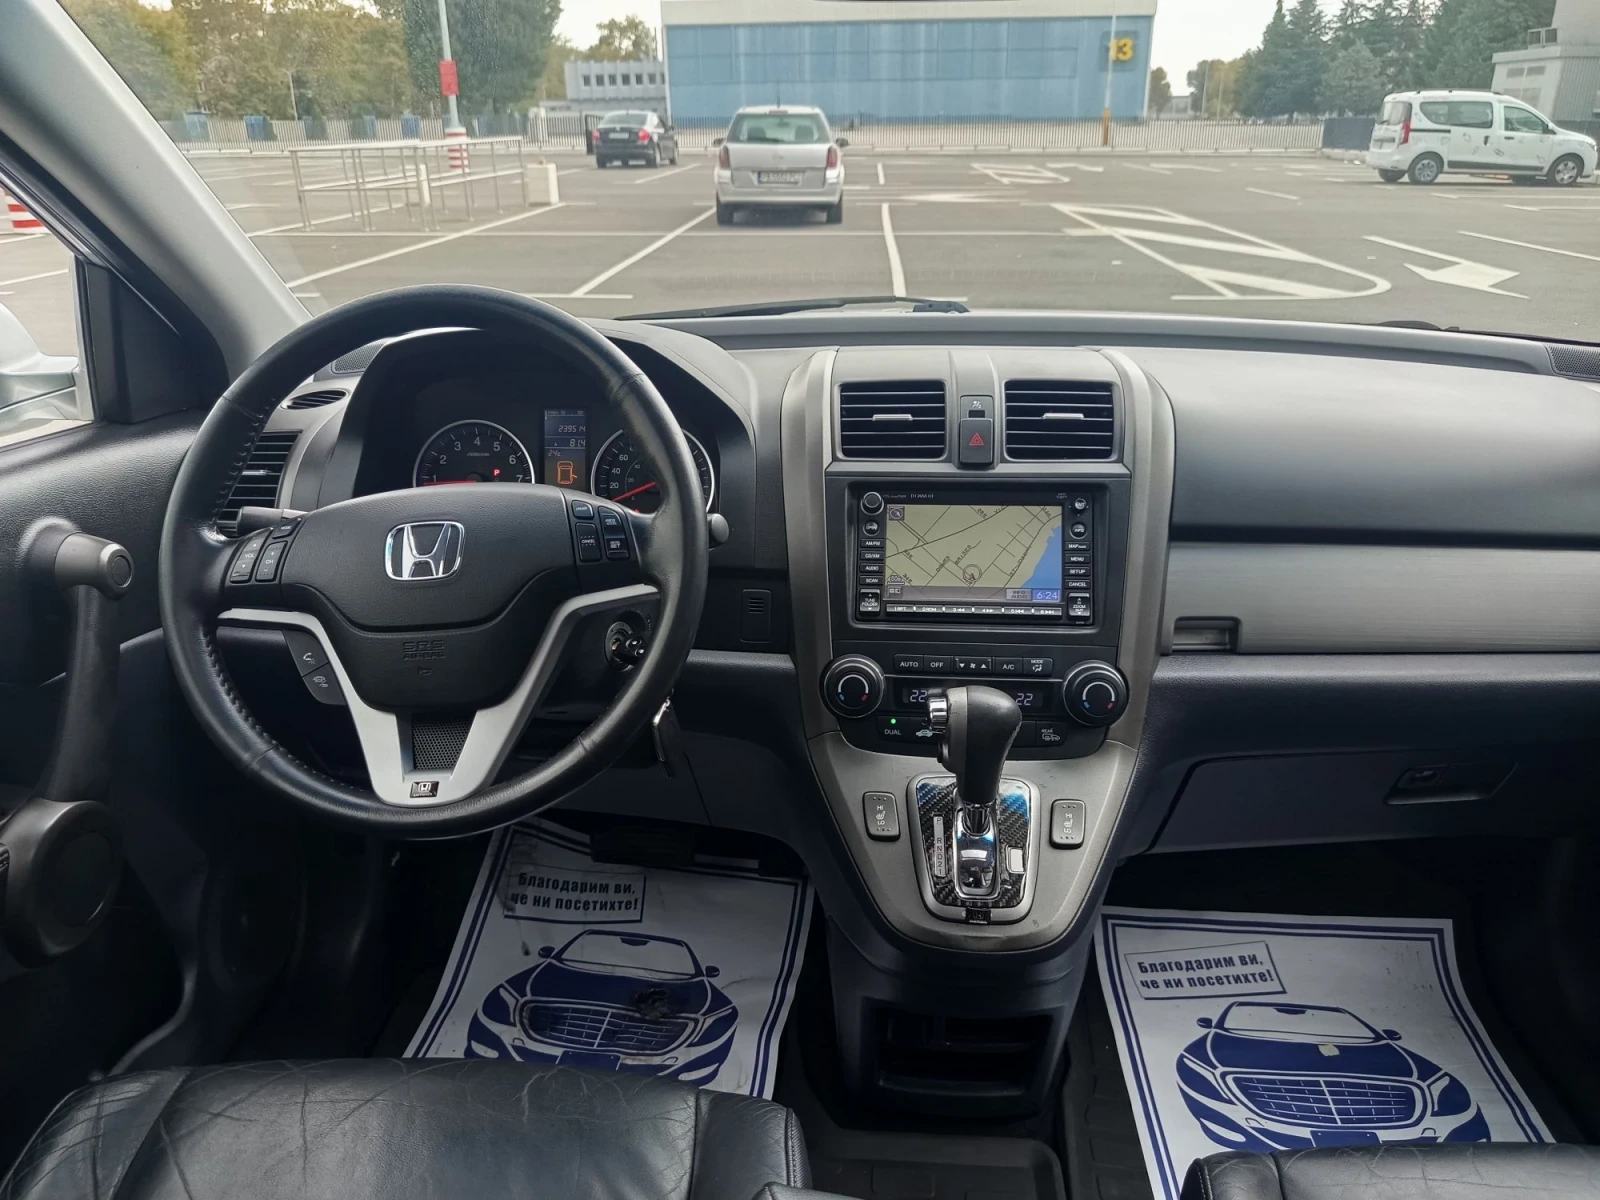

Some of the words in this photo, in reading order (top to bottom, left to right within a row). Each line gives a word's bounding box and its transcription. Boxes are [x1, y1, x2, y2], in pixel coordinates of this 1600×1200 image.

[474, 437, 480, 445] 4
[493, 443, 500, 451] 5
[440, 456, 447, 464] 2
[509, 456, 516, 464] 6
[403, 640, 445, 650] SRS
[910, 690, 928, 702] 22
[1016, 693, 1033, 706] 22
[517, 872, 609, 893] Благодарим
[614, 883, 636, 894] ви,
[511, 892, 528, 905] че
[532, 895, 550, 908] ни
[554, 898, 639, 911] посетихте!
[1138, 956, 1235, 974] Благодарим
[1238, 954, 1263, 966] ви,
[1140, 979, 1160, 989] че
[1163, 978, 1184, 988] ни
[1188, 969, 1274, 987] посетихте!
